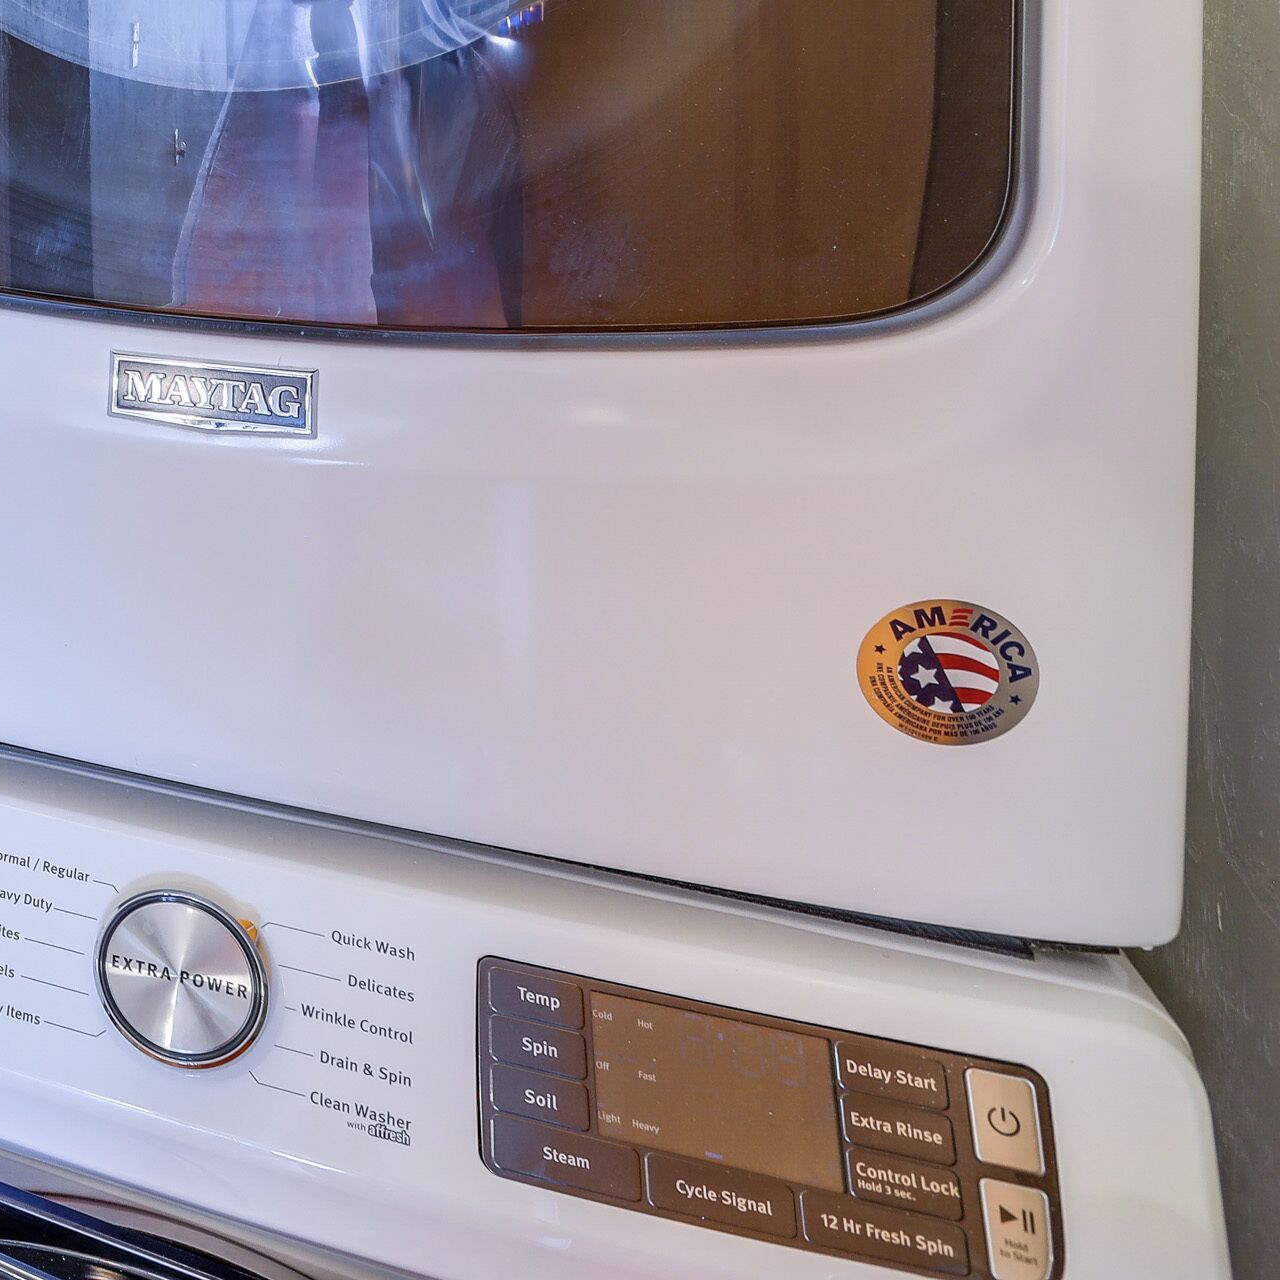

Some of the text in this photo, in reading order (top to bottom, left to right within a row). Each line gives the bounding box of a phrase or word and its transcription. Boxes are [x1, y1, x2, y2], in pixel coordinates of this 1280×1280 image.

[123, 369, 301, 418] MAYTAG
[889, 606, 1033, 684] AMERICA
[42, 861, 91, 882] Regular
[24, 894, 53, 913] Duty
[331, 930, 415, 961] Quick Wash
[112, 955, 248, 1000] EXTRA POWER
[348, 974, 415, 1003] Delicates
[516, 985, 560, 1011] Temp
[6, 1004, 41, 1025] Items
[301, 1003, 414, 1045] Wrinkle Control
[592, 1009, 653, 1031] Cold Hot
[522, 1037, 558, 1058] Spin
[320, 1050, 411, 1088] Drain & Spin
[595, 1060, 657, 1083] Off Fast
[846, 1059, 937, 1092] Delay Start
[310, 1091, 411, 1131] Clean Washer
[524, 1089, 558, 1111] Soil
[346, 1121, 411, 1146] with affresh
[597, 1110, 660, 1136] Light Heavy
[850, 1111, 943, 1145] Extra Rinse
[542, 1146, 590, 1170] Steam
[856, 1162, 960, 1198] Control Lock
[857, 1179, 916, 1201] Hold 3 sec.
[675, 1179, 773, 1217] Cycle Signal
[820, 1213, 954, 1258] 12 Hr Fresh Spin
[1000, 1249, 1038, 1266] to Start
